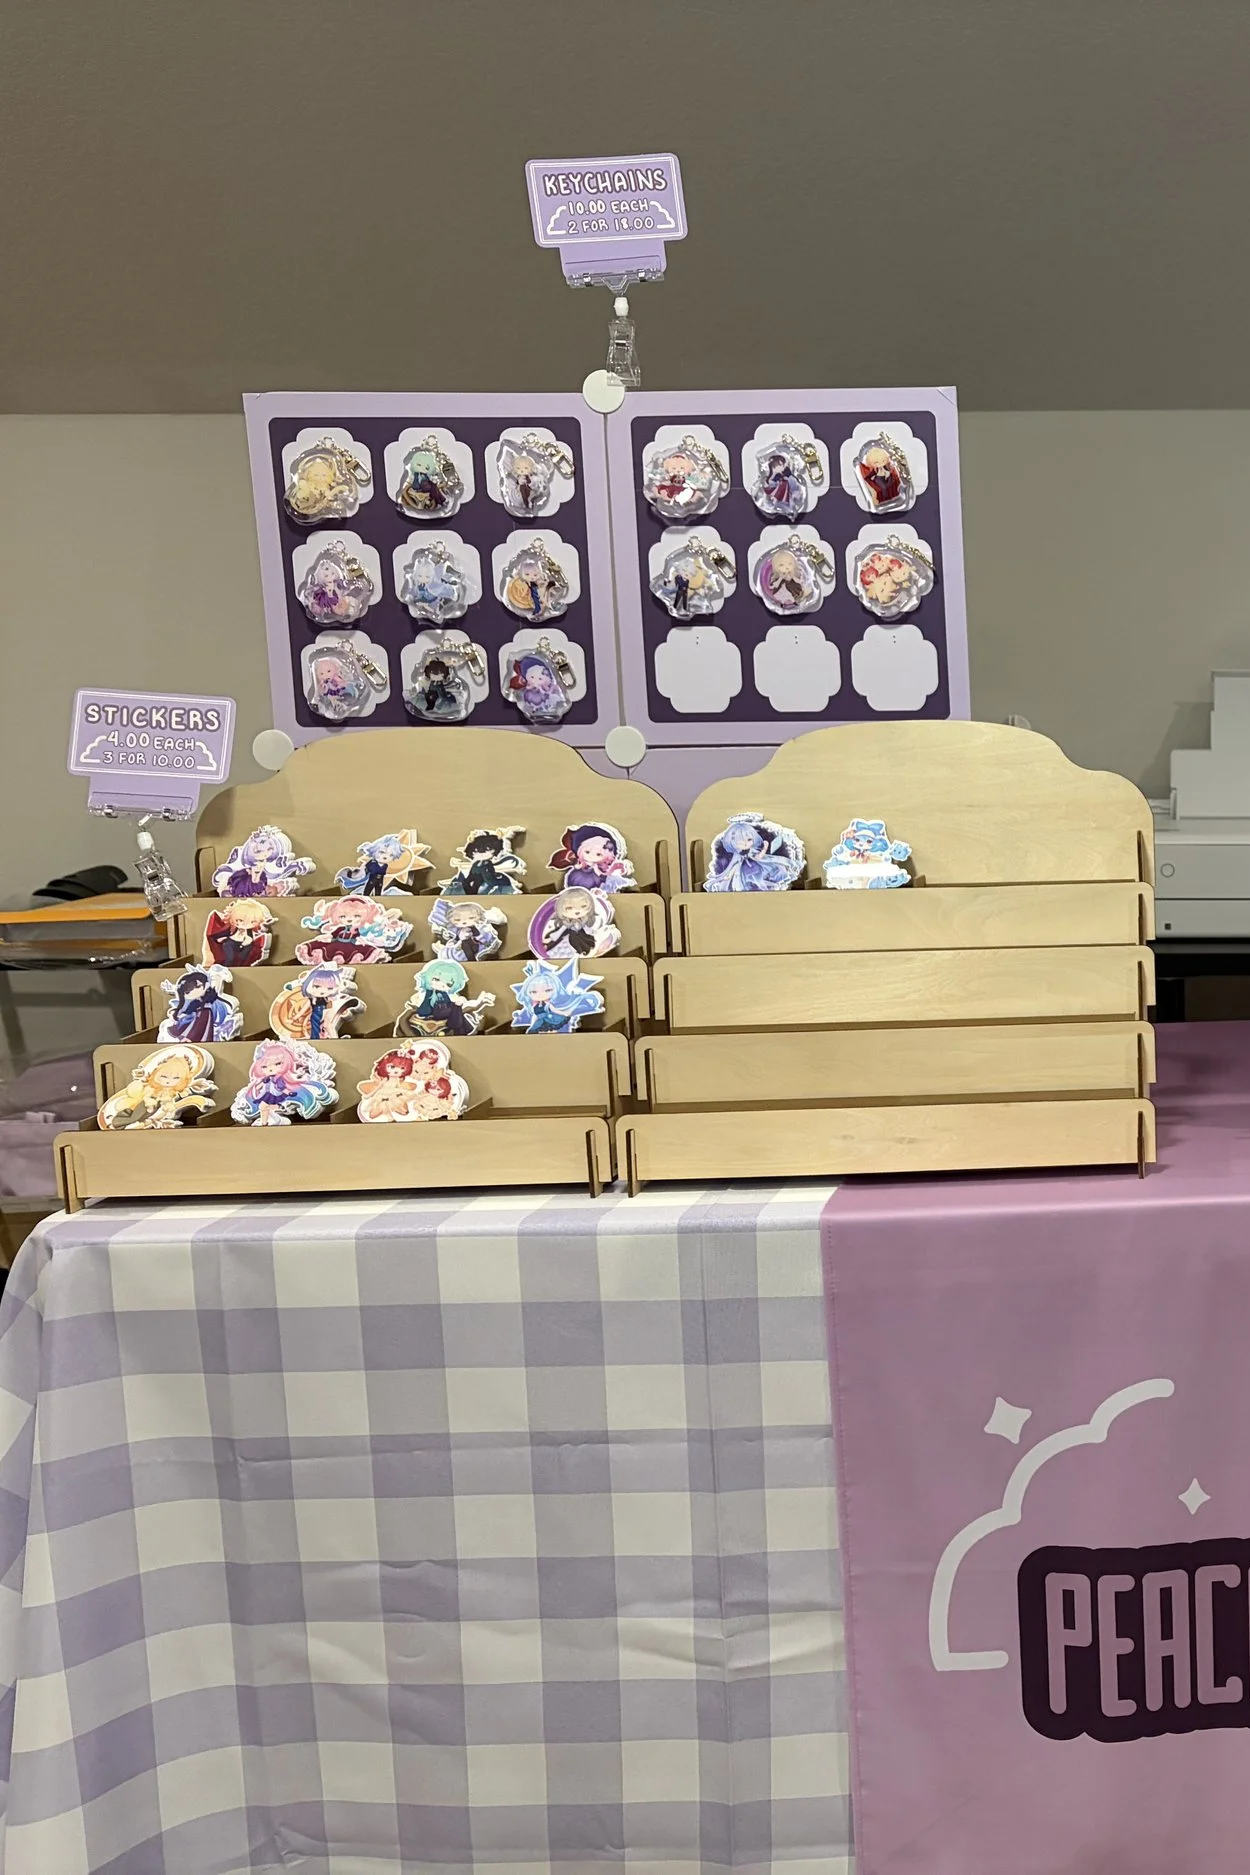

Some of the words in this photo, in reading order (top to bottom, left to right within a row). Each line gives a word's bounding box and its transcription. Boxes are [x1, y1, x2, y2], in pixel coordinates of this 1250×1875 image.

[543, 168, 667, 196] KEYCHAINS
[568, 200, 606, 215] 10.00
[611, 199, 649, 214] EACH
[568, 221, 579, 234] 2
[582, 219, 609, 233] FOR
[614, 217, 654, 232] 18.00
[86, 703, 221, 732] STICKERS
[107, 730, 150, 748] 4.00
[153, 736, 195, 751] EACH
[103, 751, 113, 765] 3
[118, 752, 146, 765] FOR
[152, 755, 195, 769] 10.00
